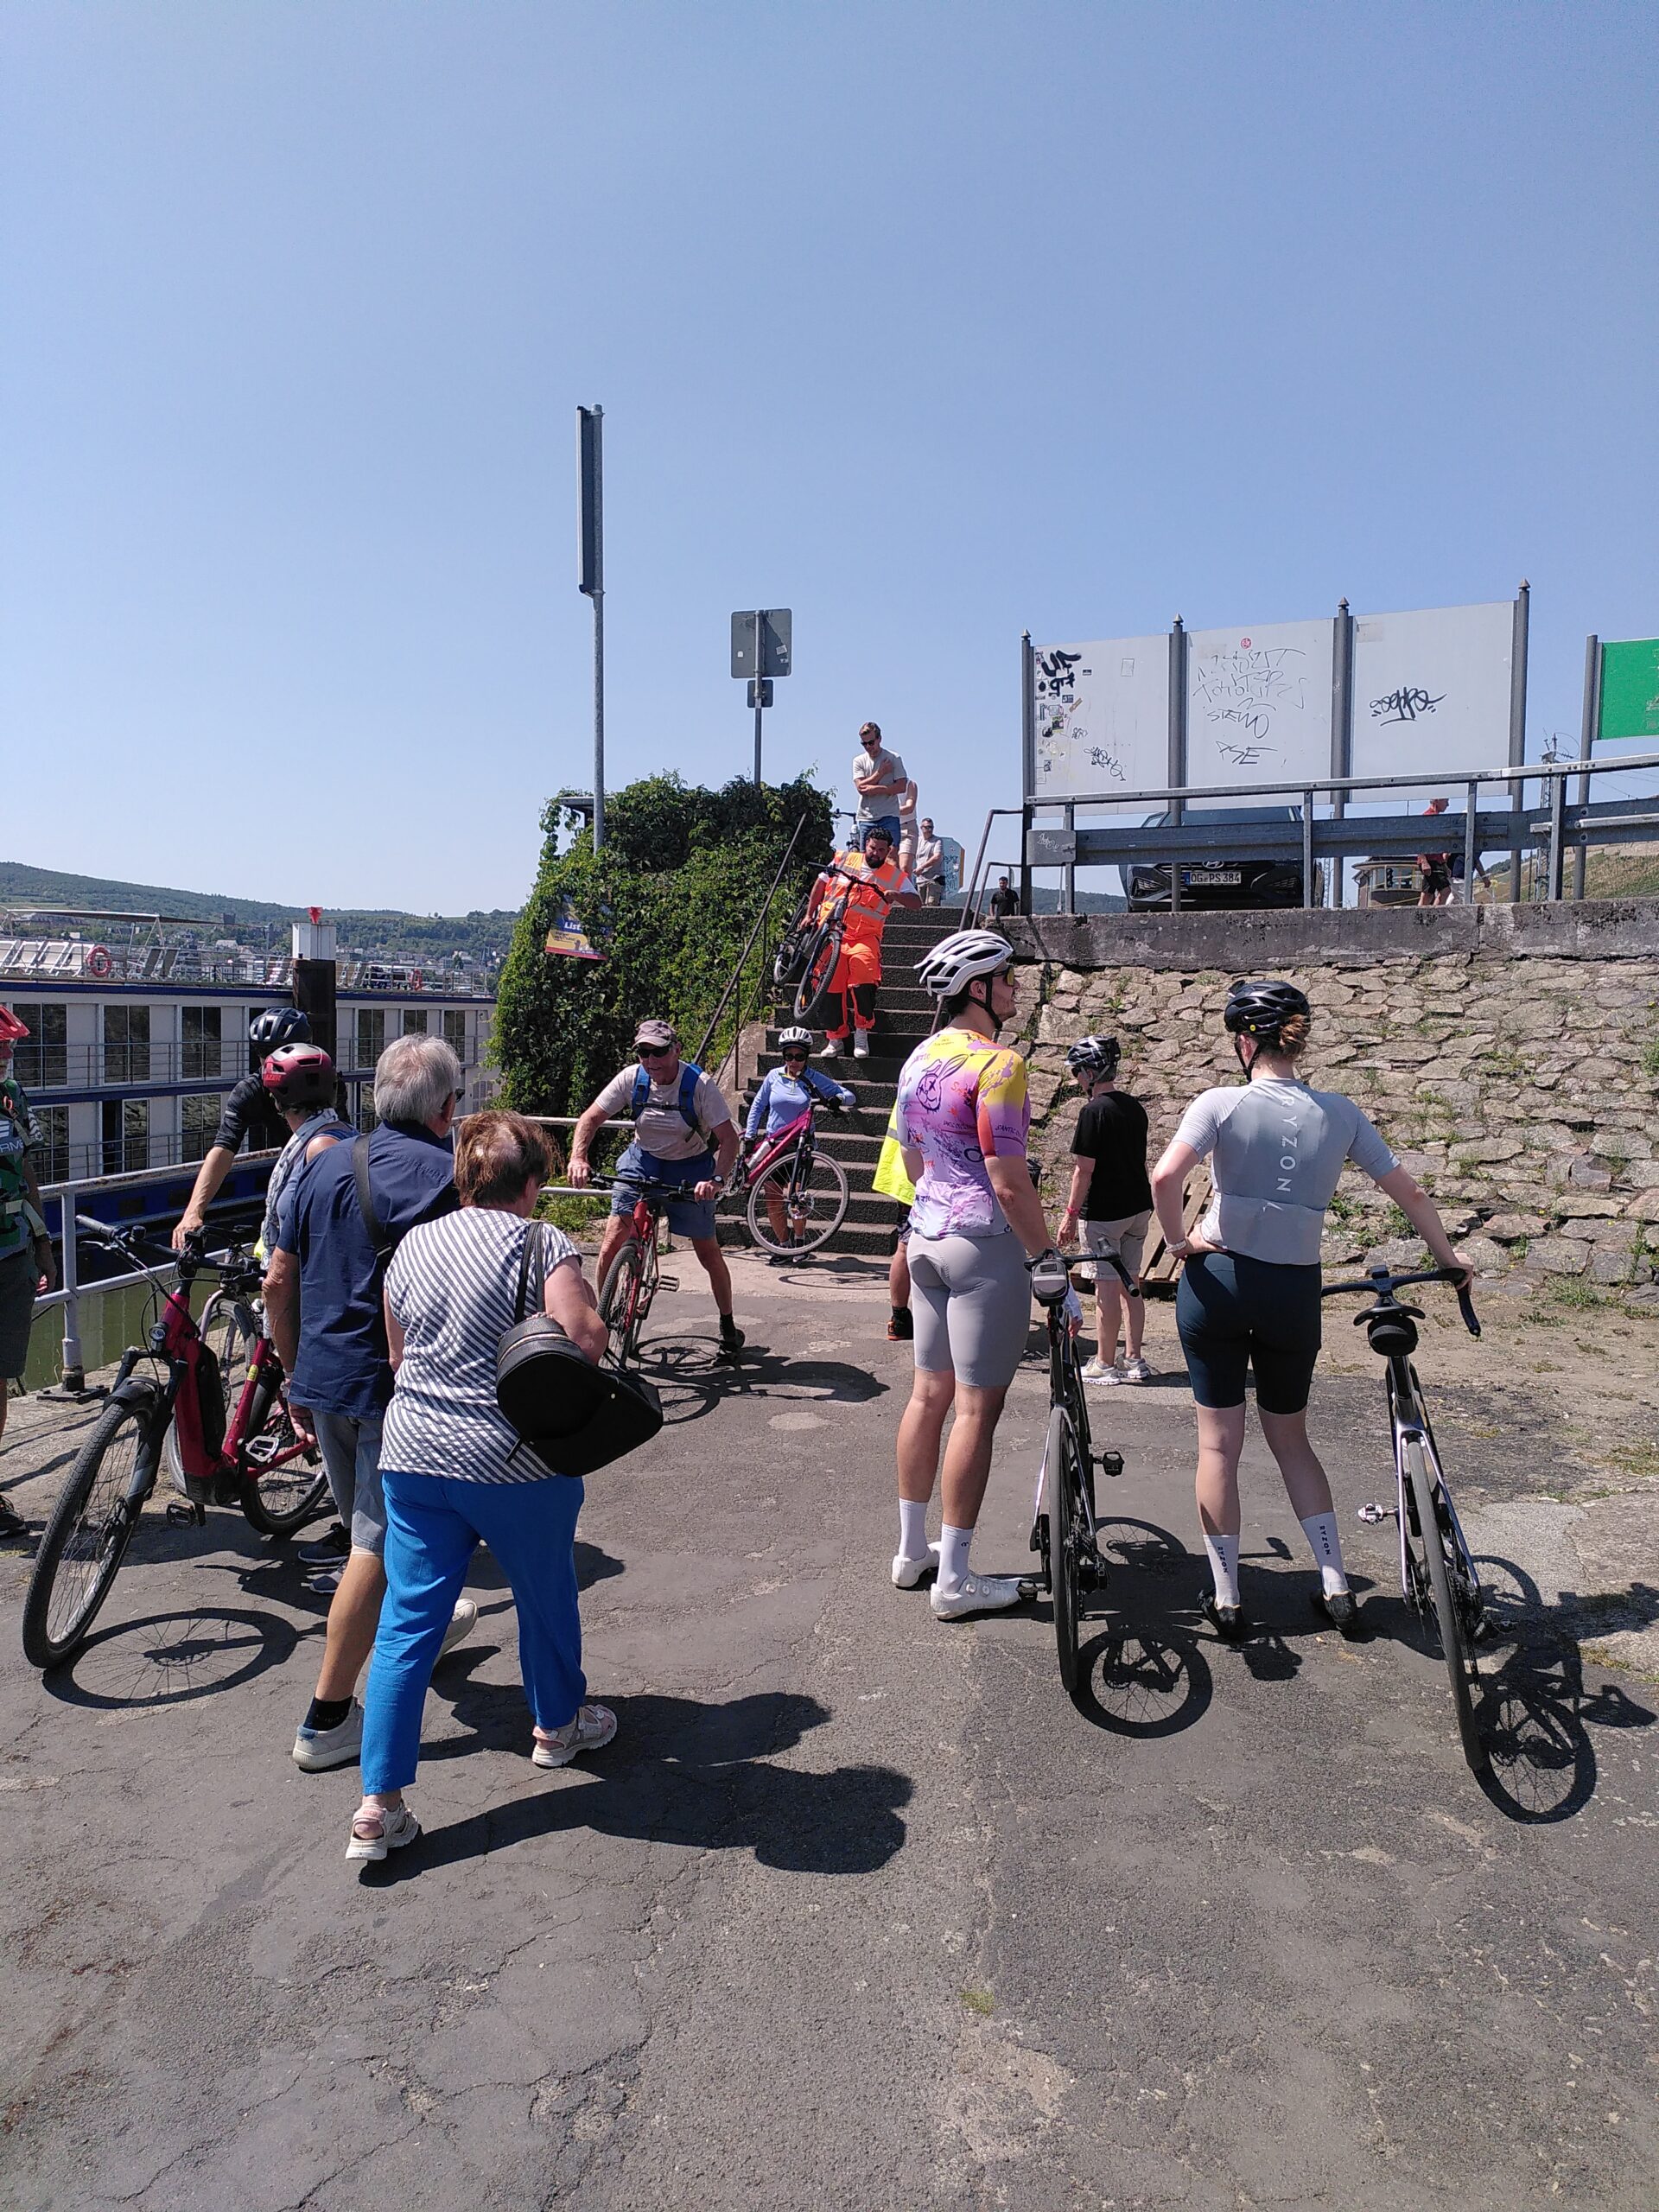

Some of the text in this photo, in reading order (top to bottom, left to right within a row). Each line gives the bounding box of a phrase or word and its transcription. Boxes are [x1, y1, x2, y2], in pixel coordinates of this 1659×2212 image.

[1209, 873, 1221, 882] PS
[1223, 873, 1239, 882] 384
[564, 921, 582, 931] List
[1276, 1096, 1298, 1192] RYZON
[1319, 1525, 1332, 1555] RYZON
[1217, 1546, 1230, 1573] RYZON
